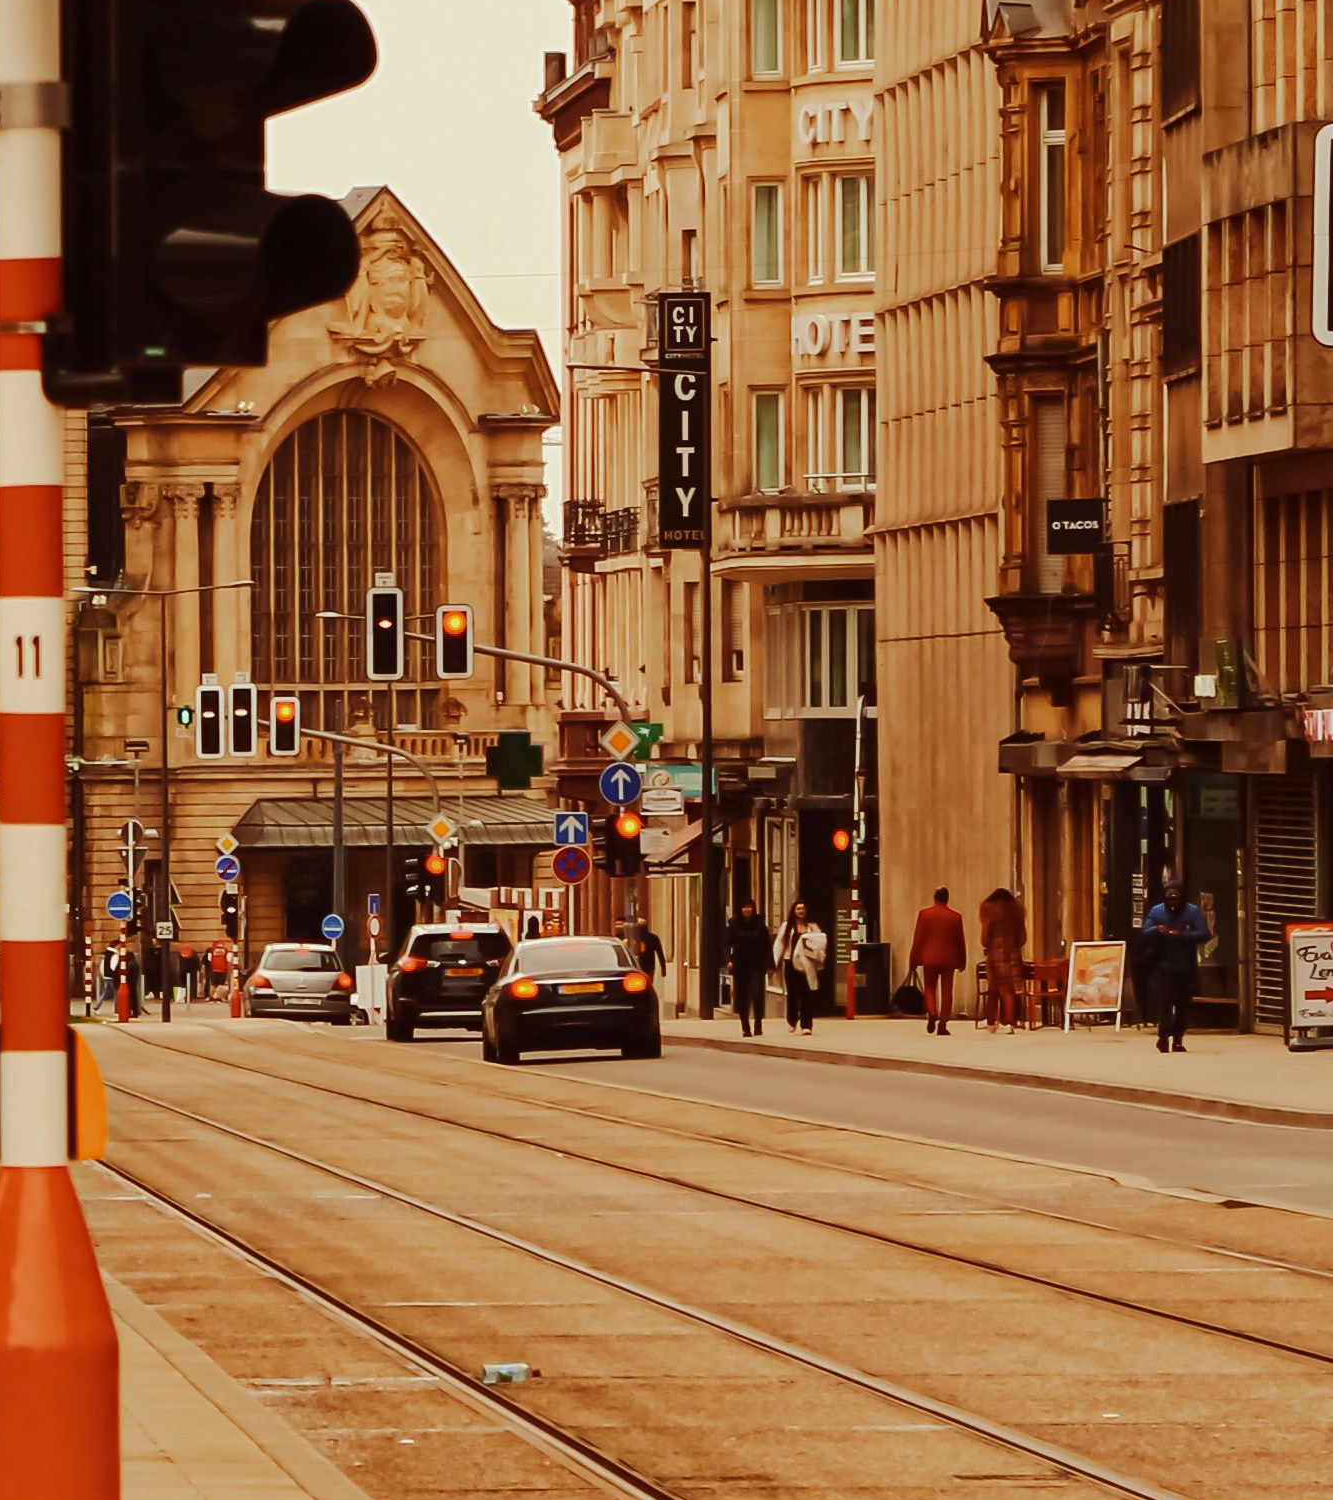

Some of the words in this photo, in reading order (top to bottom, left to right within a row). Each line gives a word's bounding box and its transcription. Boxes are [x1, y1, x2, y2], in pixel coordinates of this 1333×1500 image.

[798, 100, 874, 144] CITY
[674, 373, 696, 517] CITY
[16, 635, 40, 677] 11
[158, 925, 173, 936] 25
